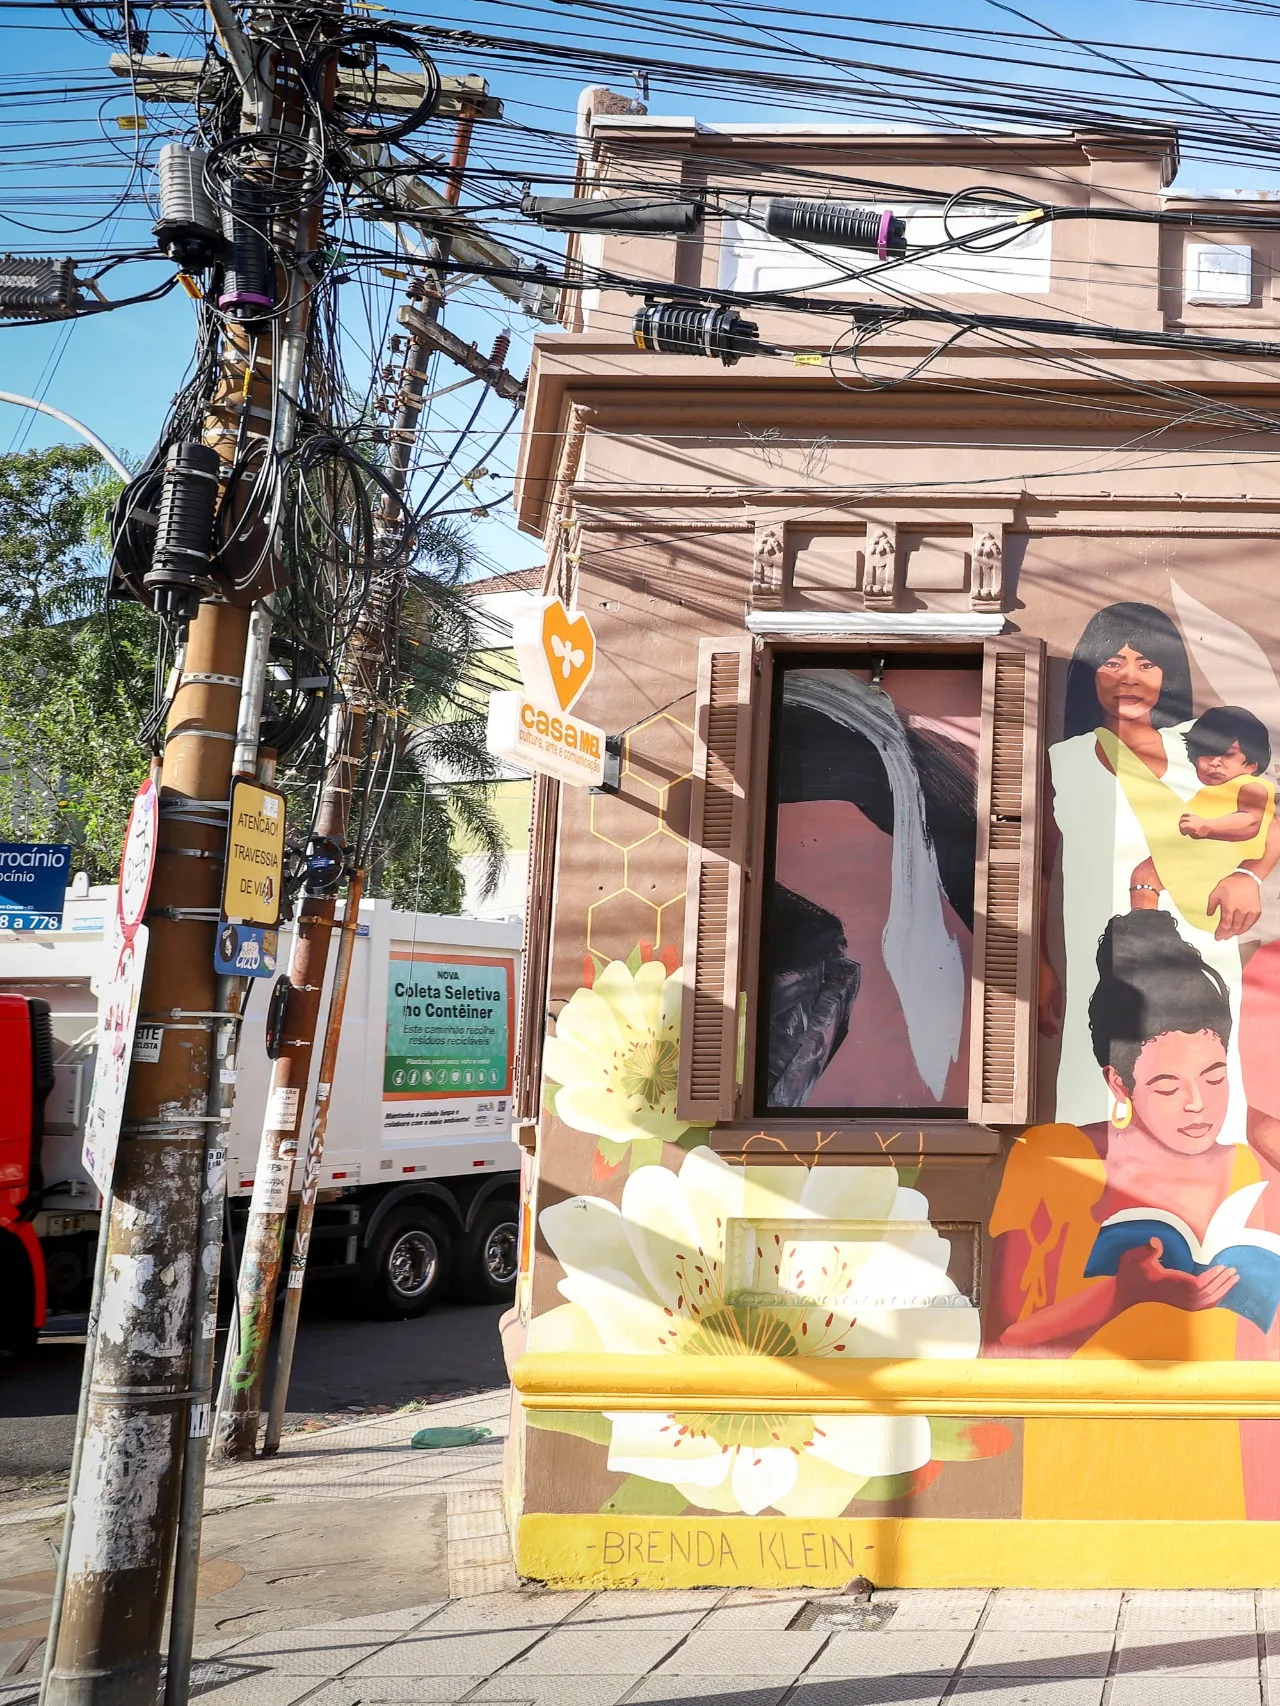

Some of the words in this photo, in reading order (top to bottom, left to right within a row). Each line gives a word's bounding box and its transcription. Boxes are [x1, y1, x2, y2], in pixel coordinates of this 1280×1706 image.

[521, 704, 578, 749] casa
[545, 740, 558, 755] arte
[564, 748, 600, 774] comunicação
[0, 847, 65, 868] rocínio
[234, 843, 278, 868] TRAVESSIA
[240, 878, 252, 895] DE
[13, 917, 23, 929] a
[29, 915, 58, 929] 778
[437, 971, 460, 980] NOVA
[395, 982, 441, 999] Coleta
[444, 985, 501, 1001] Seletiva
[404, 1005, 421, 1017] no
[425, 1002, 493, 1019] Contêiner
[403, 1024, 424, 1034] Este
[466, 1026, 496, 1035] recolhe
[420, 1110, 439, 1118] cidade
